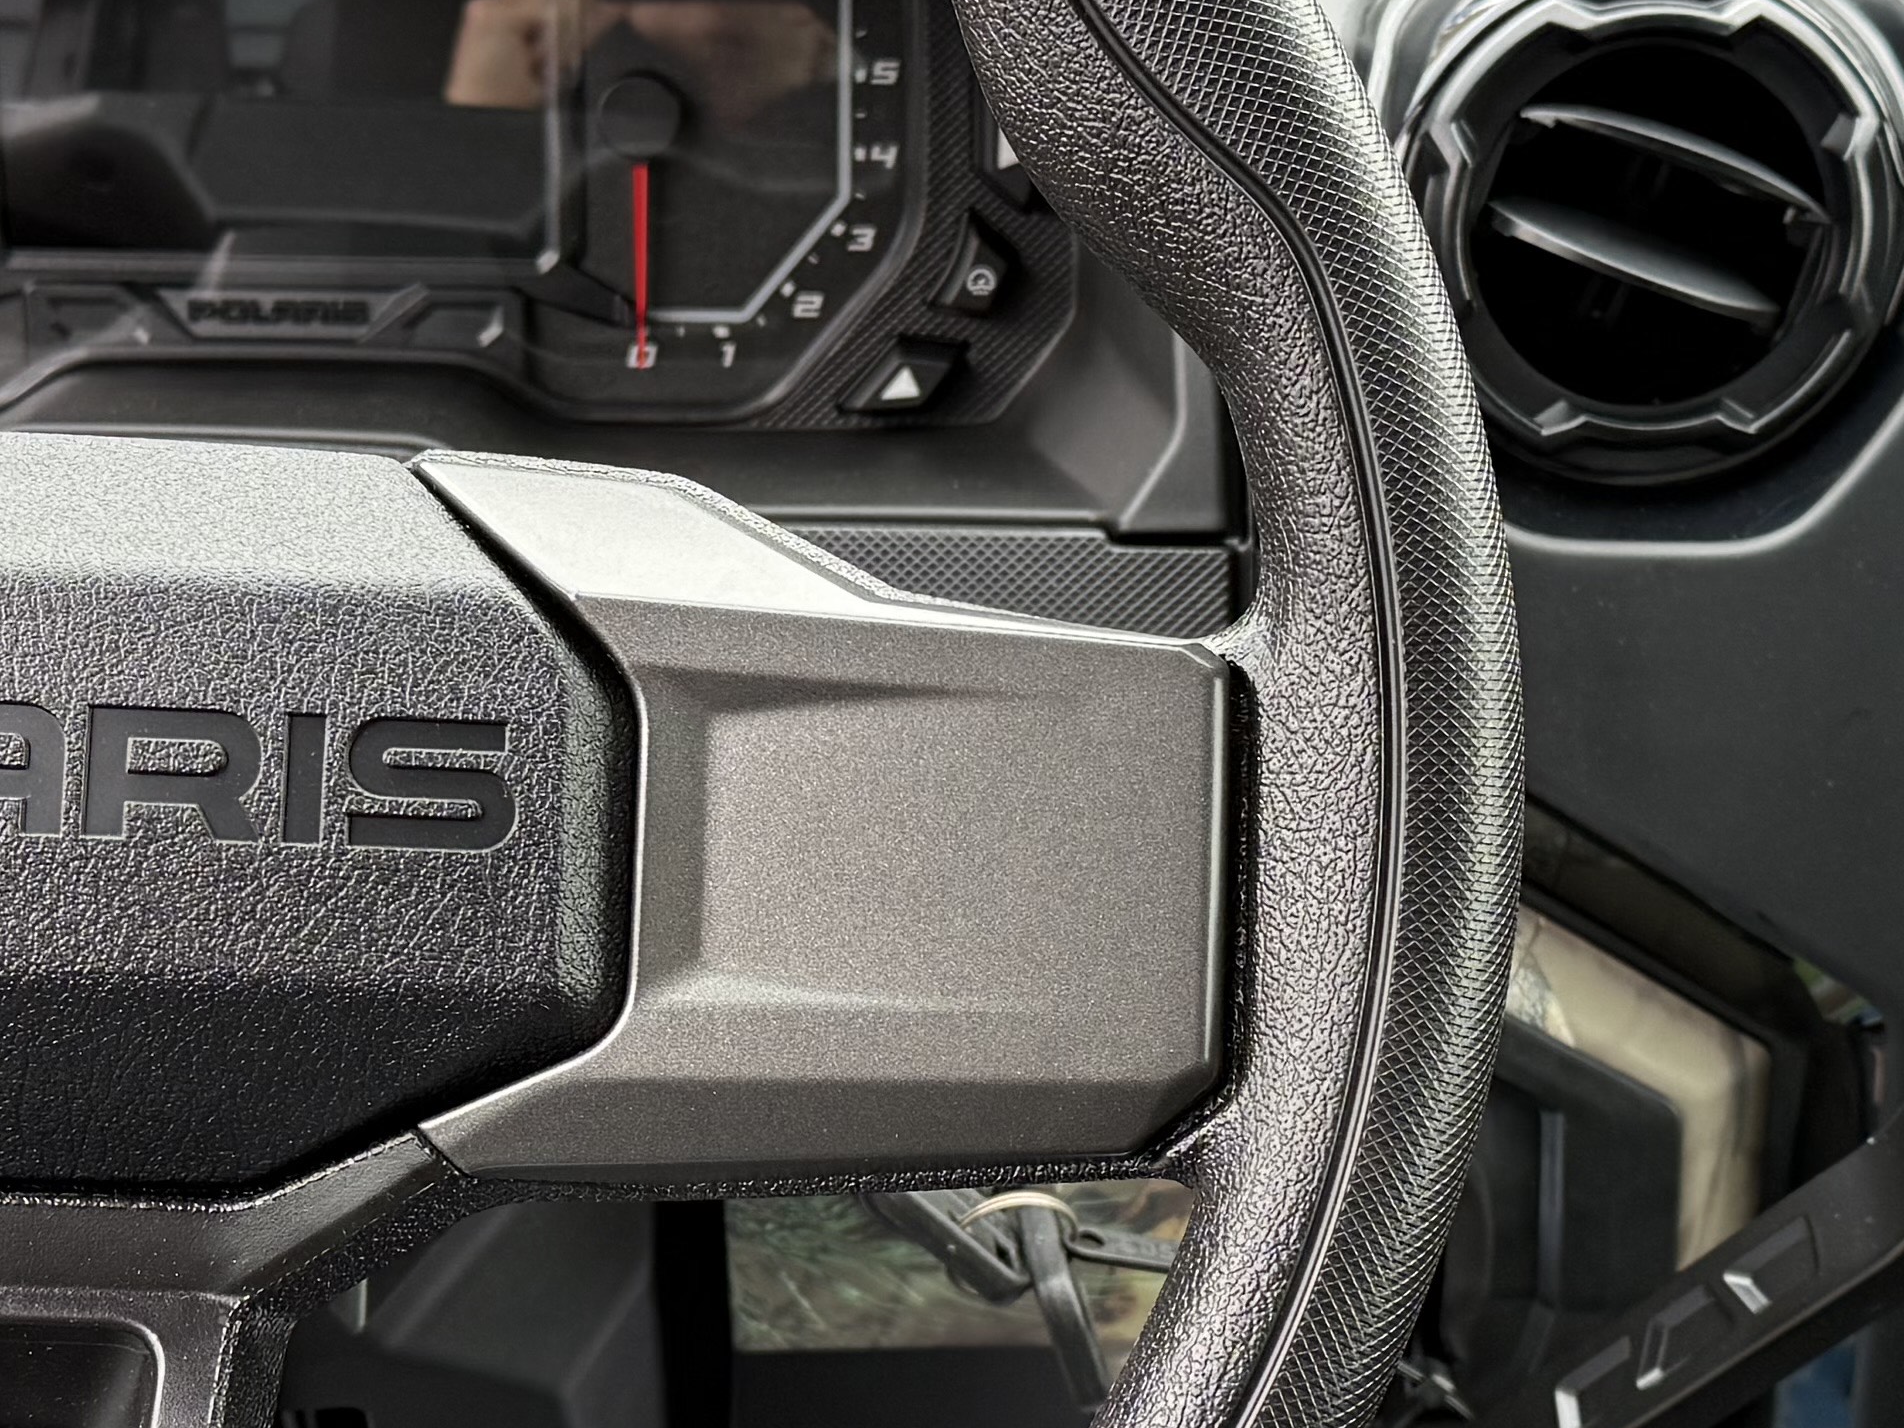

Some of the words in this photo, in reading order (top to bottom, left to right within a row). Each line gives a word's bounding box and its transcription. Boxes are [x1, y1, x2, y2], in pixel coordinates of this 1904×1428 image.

[870, 60, 900, 85] 5
[870, 144, 898, 169] 4
[847, 226, 877, 252] 3
[188, 299, 369, 326] POLARIS
[791, 290, 824, 318] 2
[626, 344, 658, 369] 0
[720, 343, 737, 368] 1
